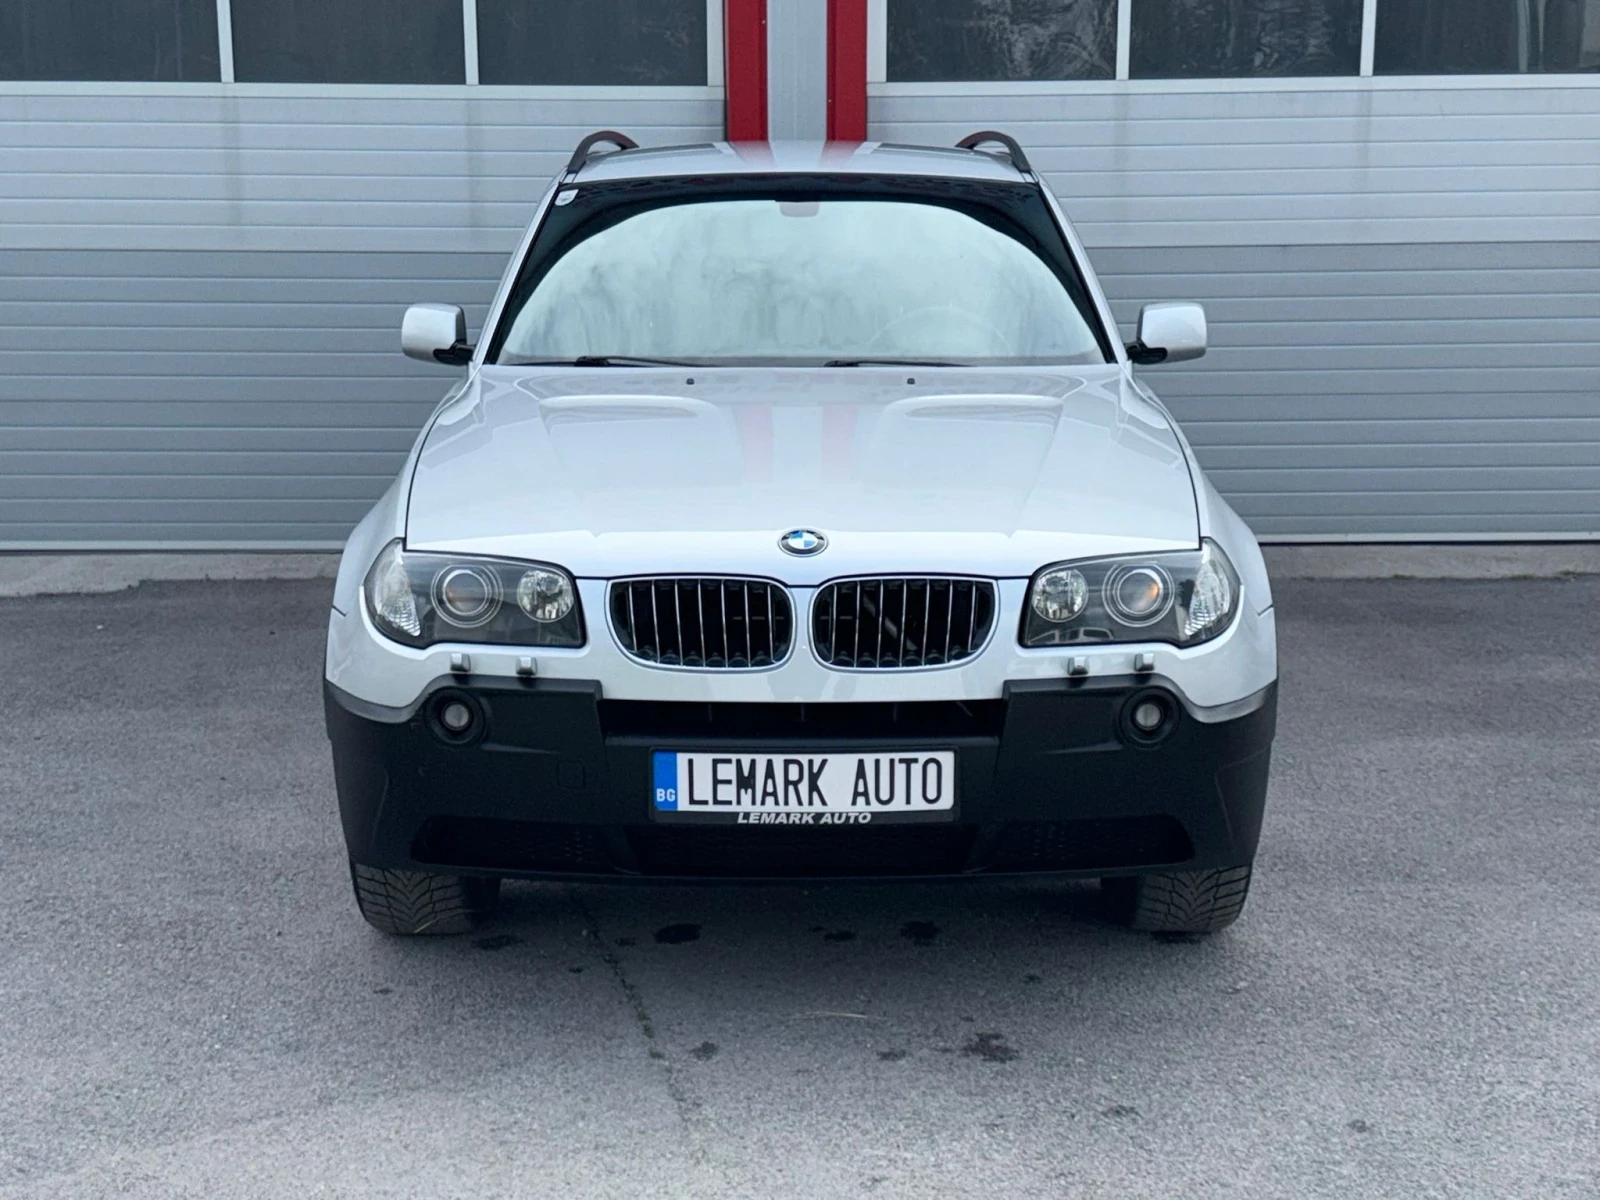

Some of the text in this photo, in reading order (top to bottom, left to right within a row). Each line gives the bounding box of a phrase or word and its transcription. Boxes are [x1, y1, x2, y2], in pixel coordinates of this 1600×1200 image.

[687, 757, 943, 807] LEMARK AUTO
[656, 788, 676, 802] BG
[736, 811, 872, 825] LEMARK AUTO
